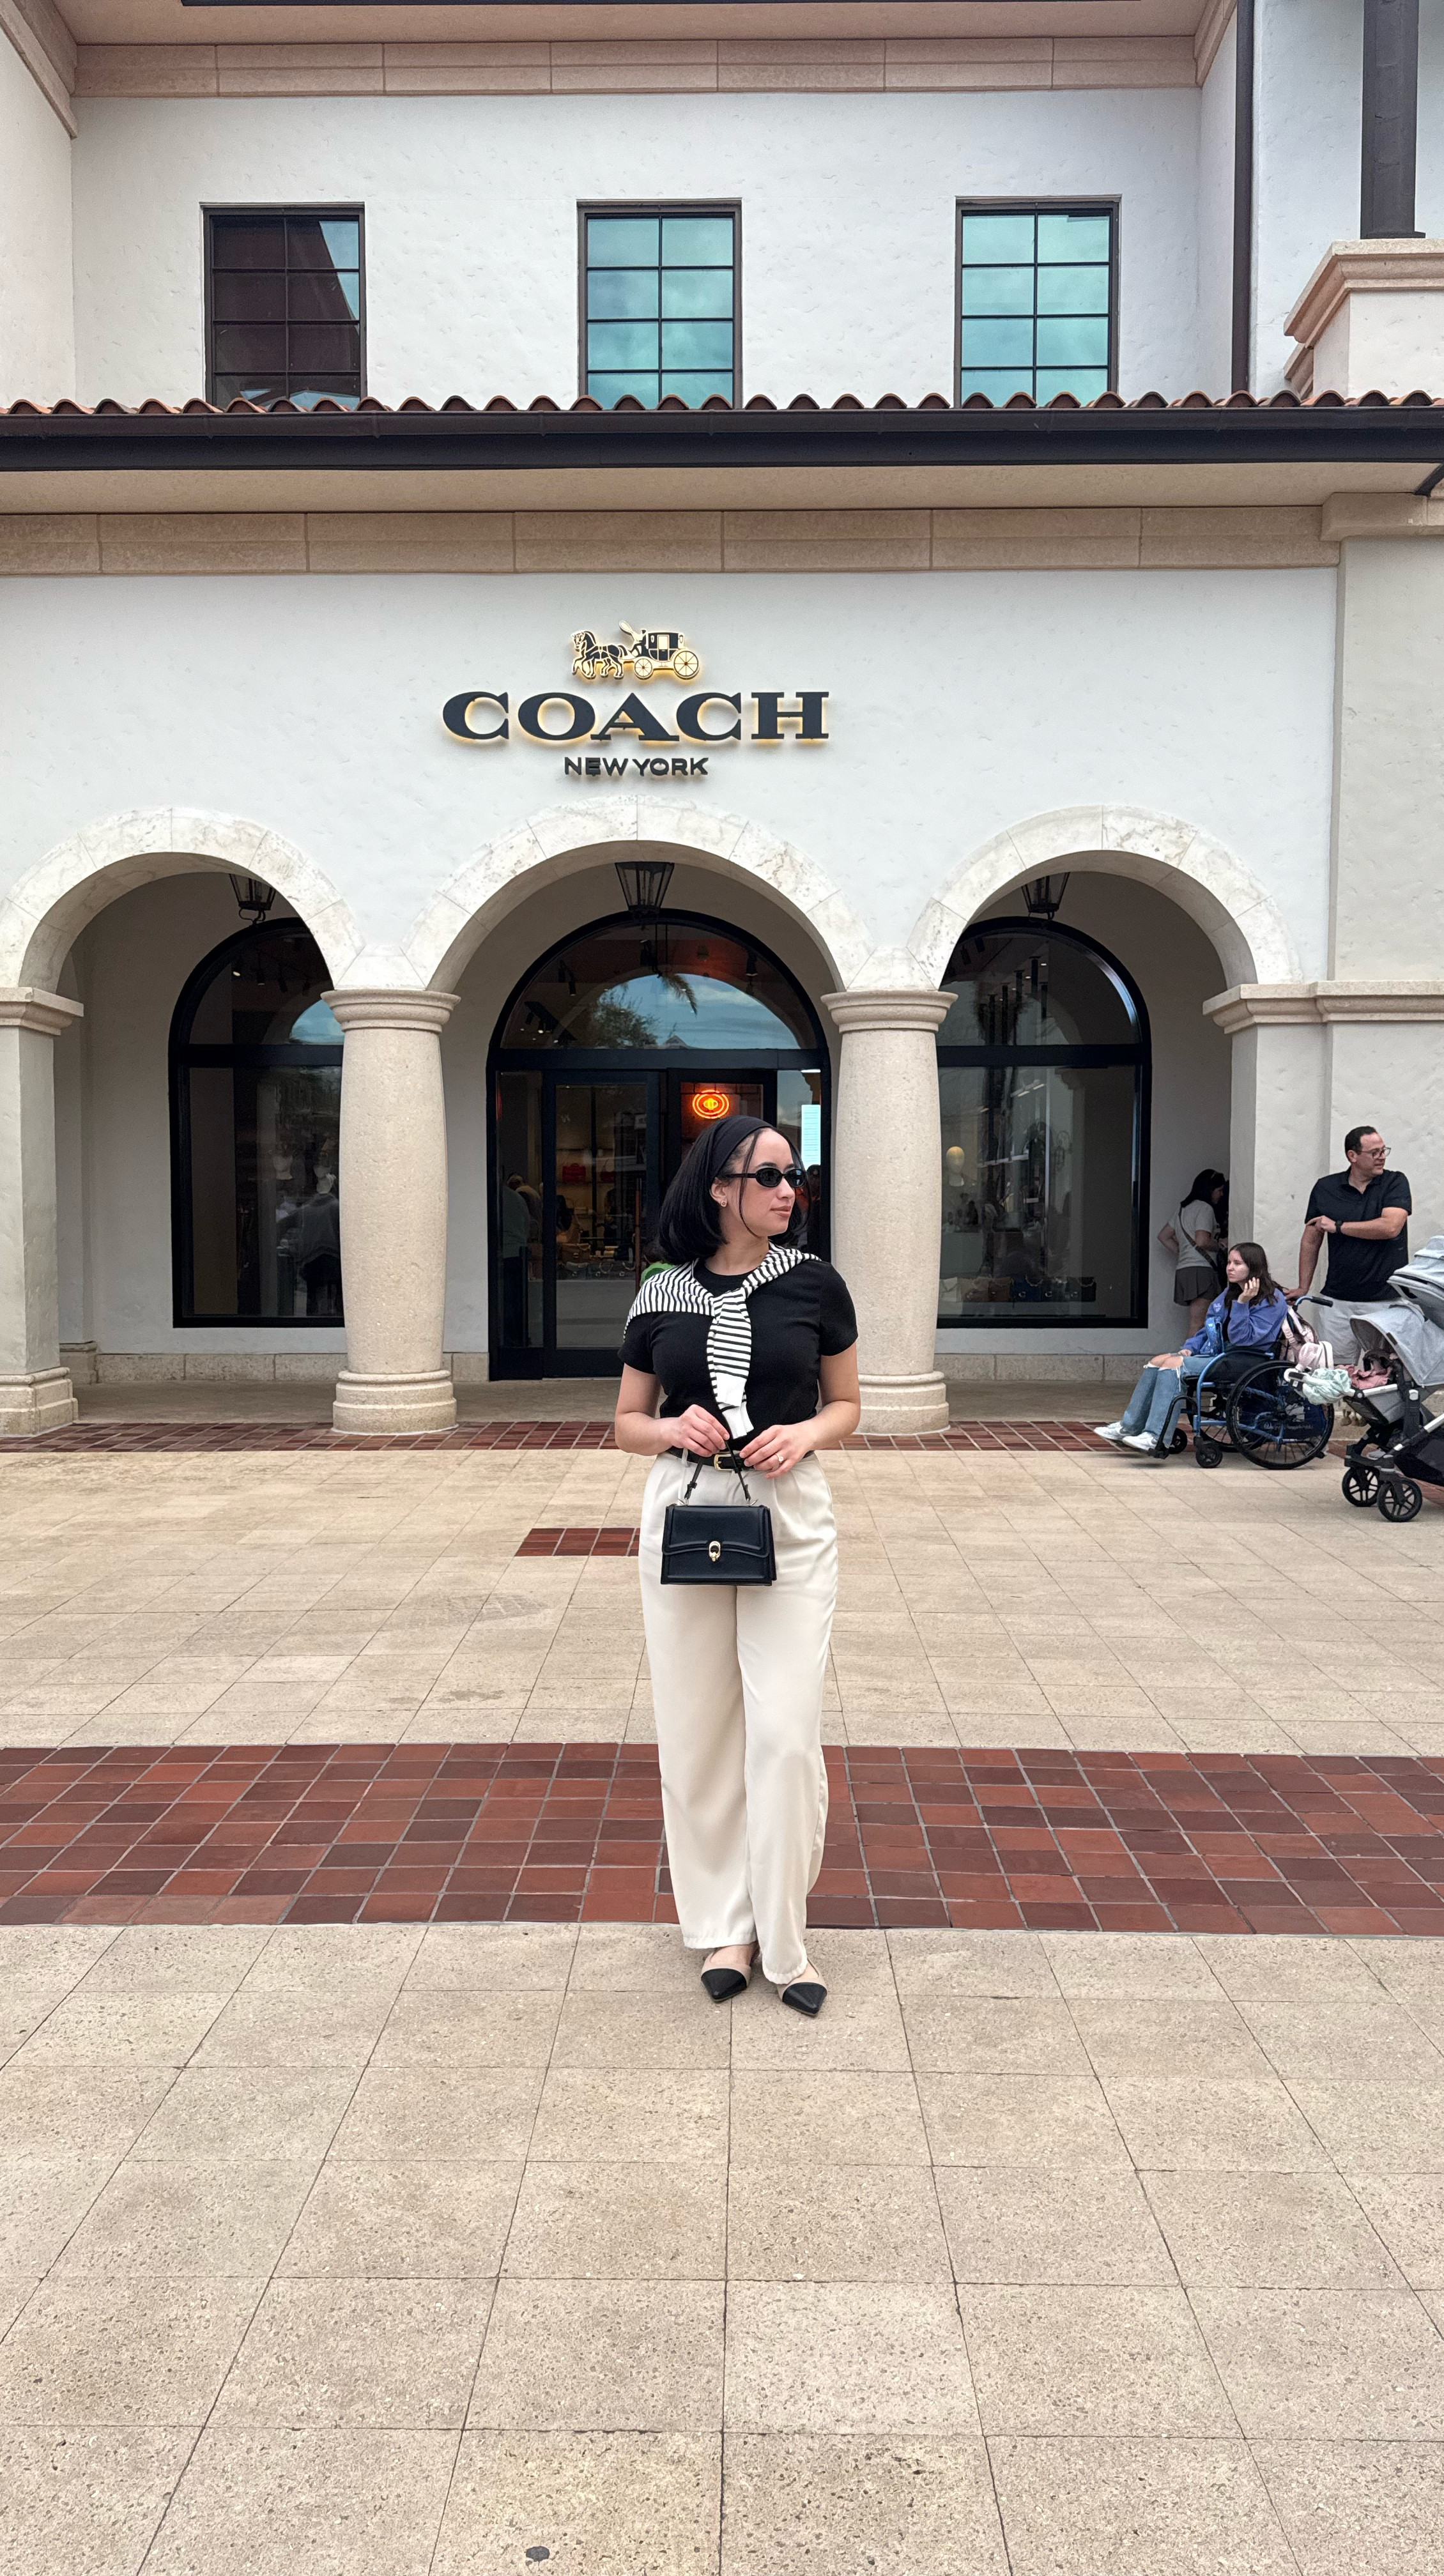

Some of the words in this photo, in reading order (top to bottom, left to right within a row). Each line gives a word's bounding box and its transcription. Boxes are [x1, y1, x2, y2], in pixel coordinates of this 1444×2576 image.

[443, 691, 829, 742] COACH
[564, 757, 629, 777] NEW
[632, 758, 709, 777] YORK
